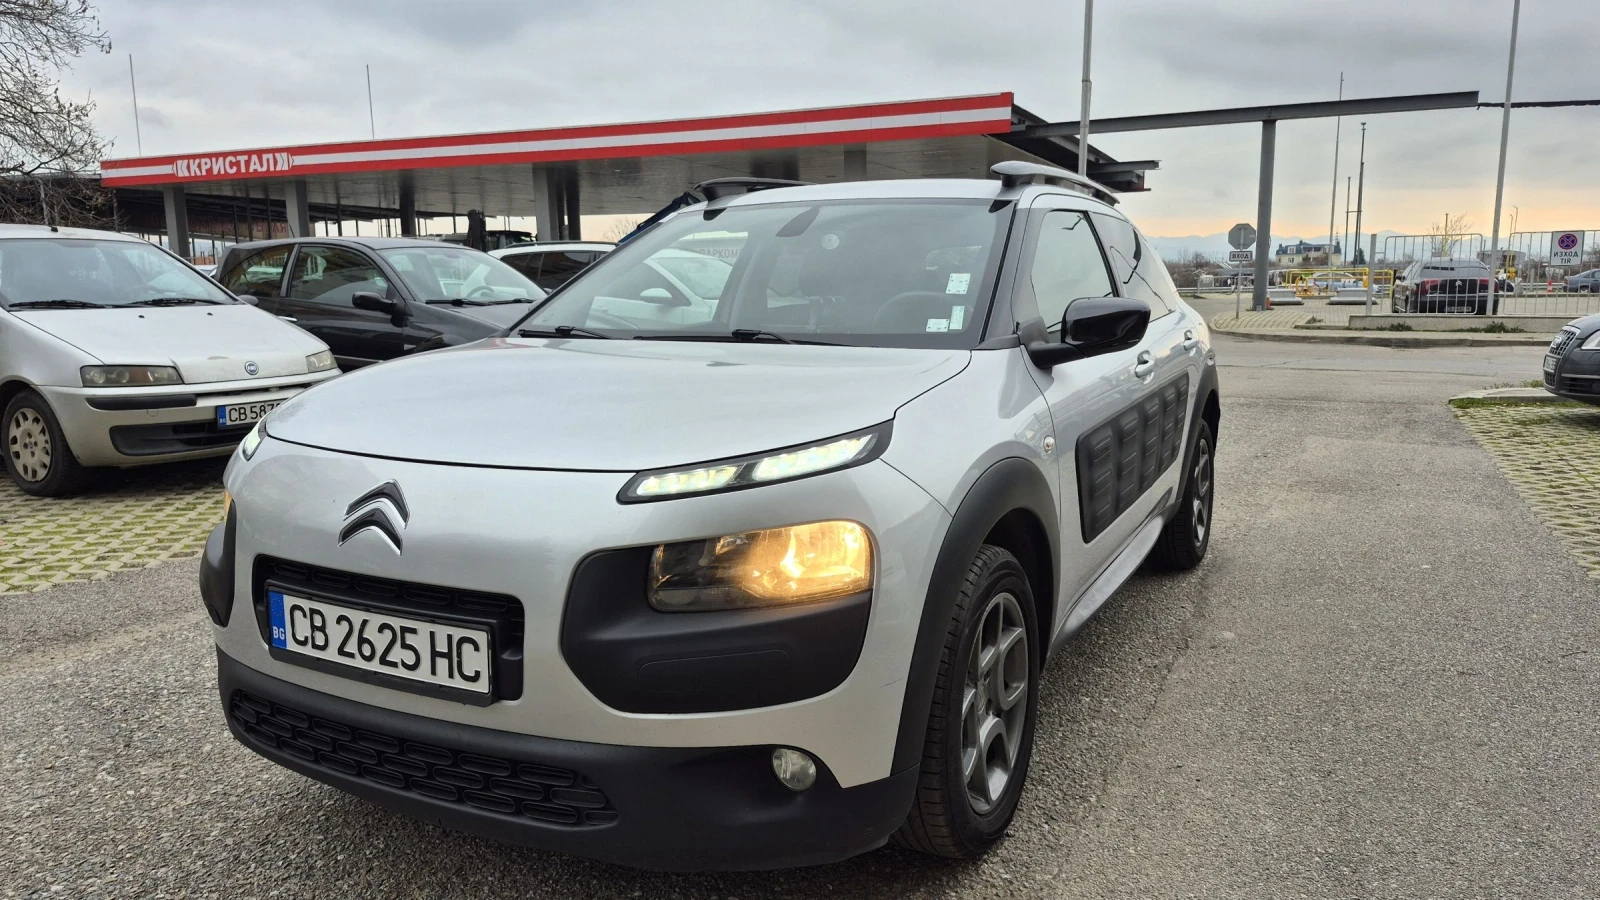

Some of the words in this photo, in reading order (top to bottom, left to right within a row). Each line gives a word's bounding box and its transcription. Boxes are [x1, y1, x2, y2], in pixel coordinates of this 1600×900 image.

[189, 153, 275, 176] КРИСТАЛ
[228, 407, 247, 422] CB
[250, 403, 280, 420] 587
[272, 626, 285, 640] BG
[289, 604, 329, 651] CB
[335, 614, 421, 671] 2625
[429, 630, 481, 683] HC
